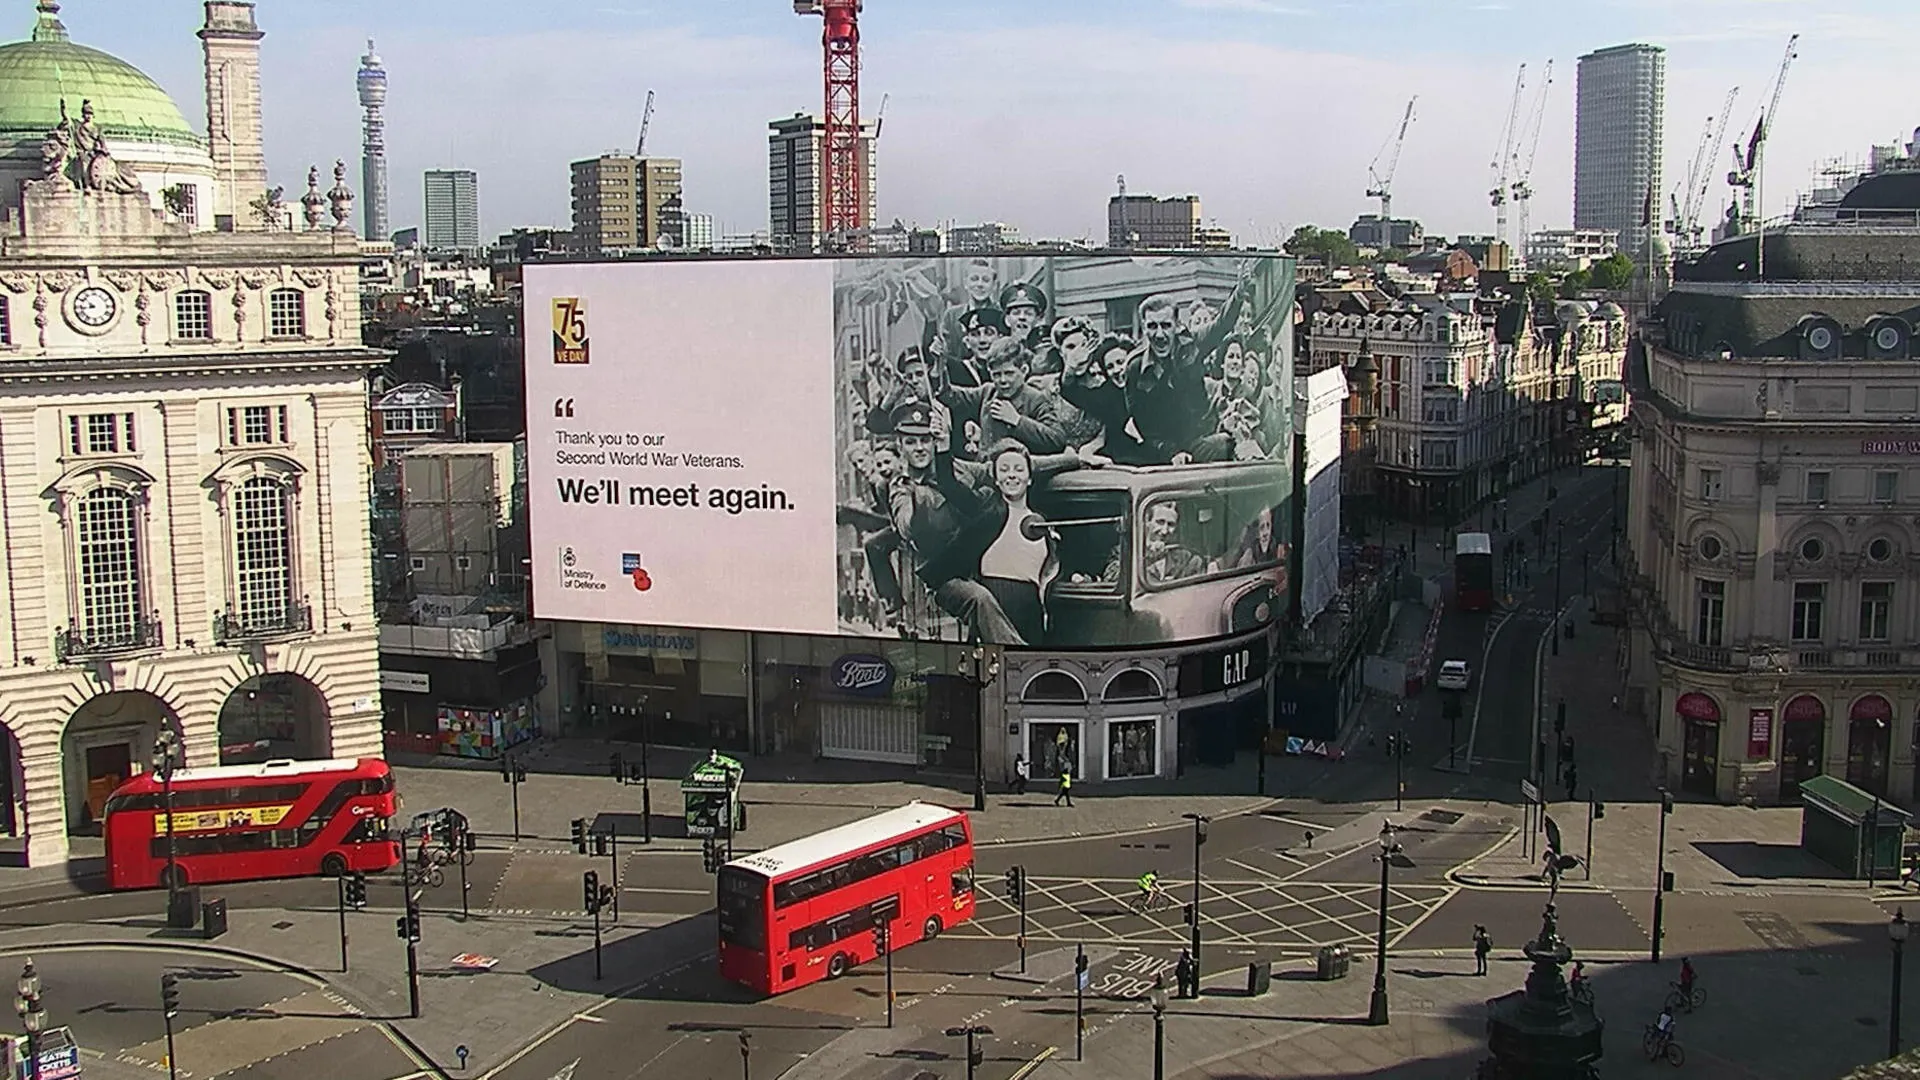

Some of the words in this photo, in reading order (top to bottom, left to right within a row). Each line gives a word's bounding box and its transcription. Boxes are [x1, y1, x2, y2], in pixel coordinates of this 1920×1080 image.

[556, 299, 586, 343] 75
[556, 351, 568, 362] VE
[569, 351, 586, 362] DAY
[555, 430, 595, 445] Thank
[598, 433, 622, 448] you
[626, 432, 640, 446] to
[642, 434, 665, 447] our
[1863, 440, 1904, 453] BODY
[556, 450, 606, 465] Second
[609, 451, 649, 467] World
[651, 452, 679, 467] War
[682, 453, 745, 469] Veterans.
[556, 478, 620, 505] We'll
[628, 482, 700, 508] meet
[707, 483, 796, 516] again.
[563, 569, 594, 581] Ministry
[563, 580, 573, 589] of
[573, 579, 607, 590] Defence
[620, 632, 695, 650] BARCLAYS
[836, 660, 887, 689] Boots
[1223, 649, 1250, 685] GAP
[1090, 973, 1158, 998] BUS
